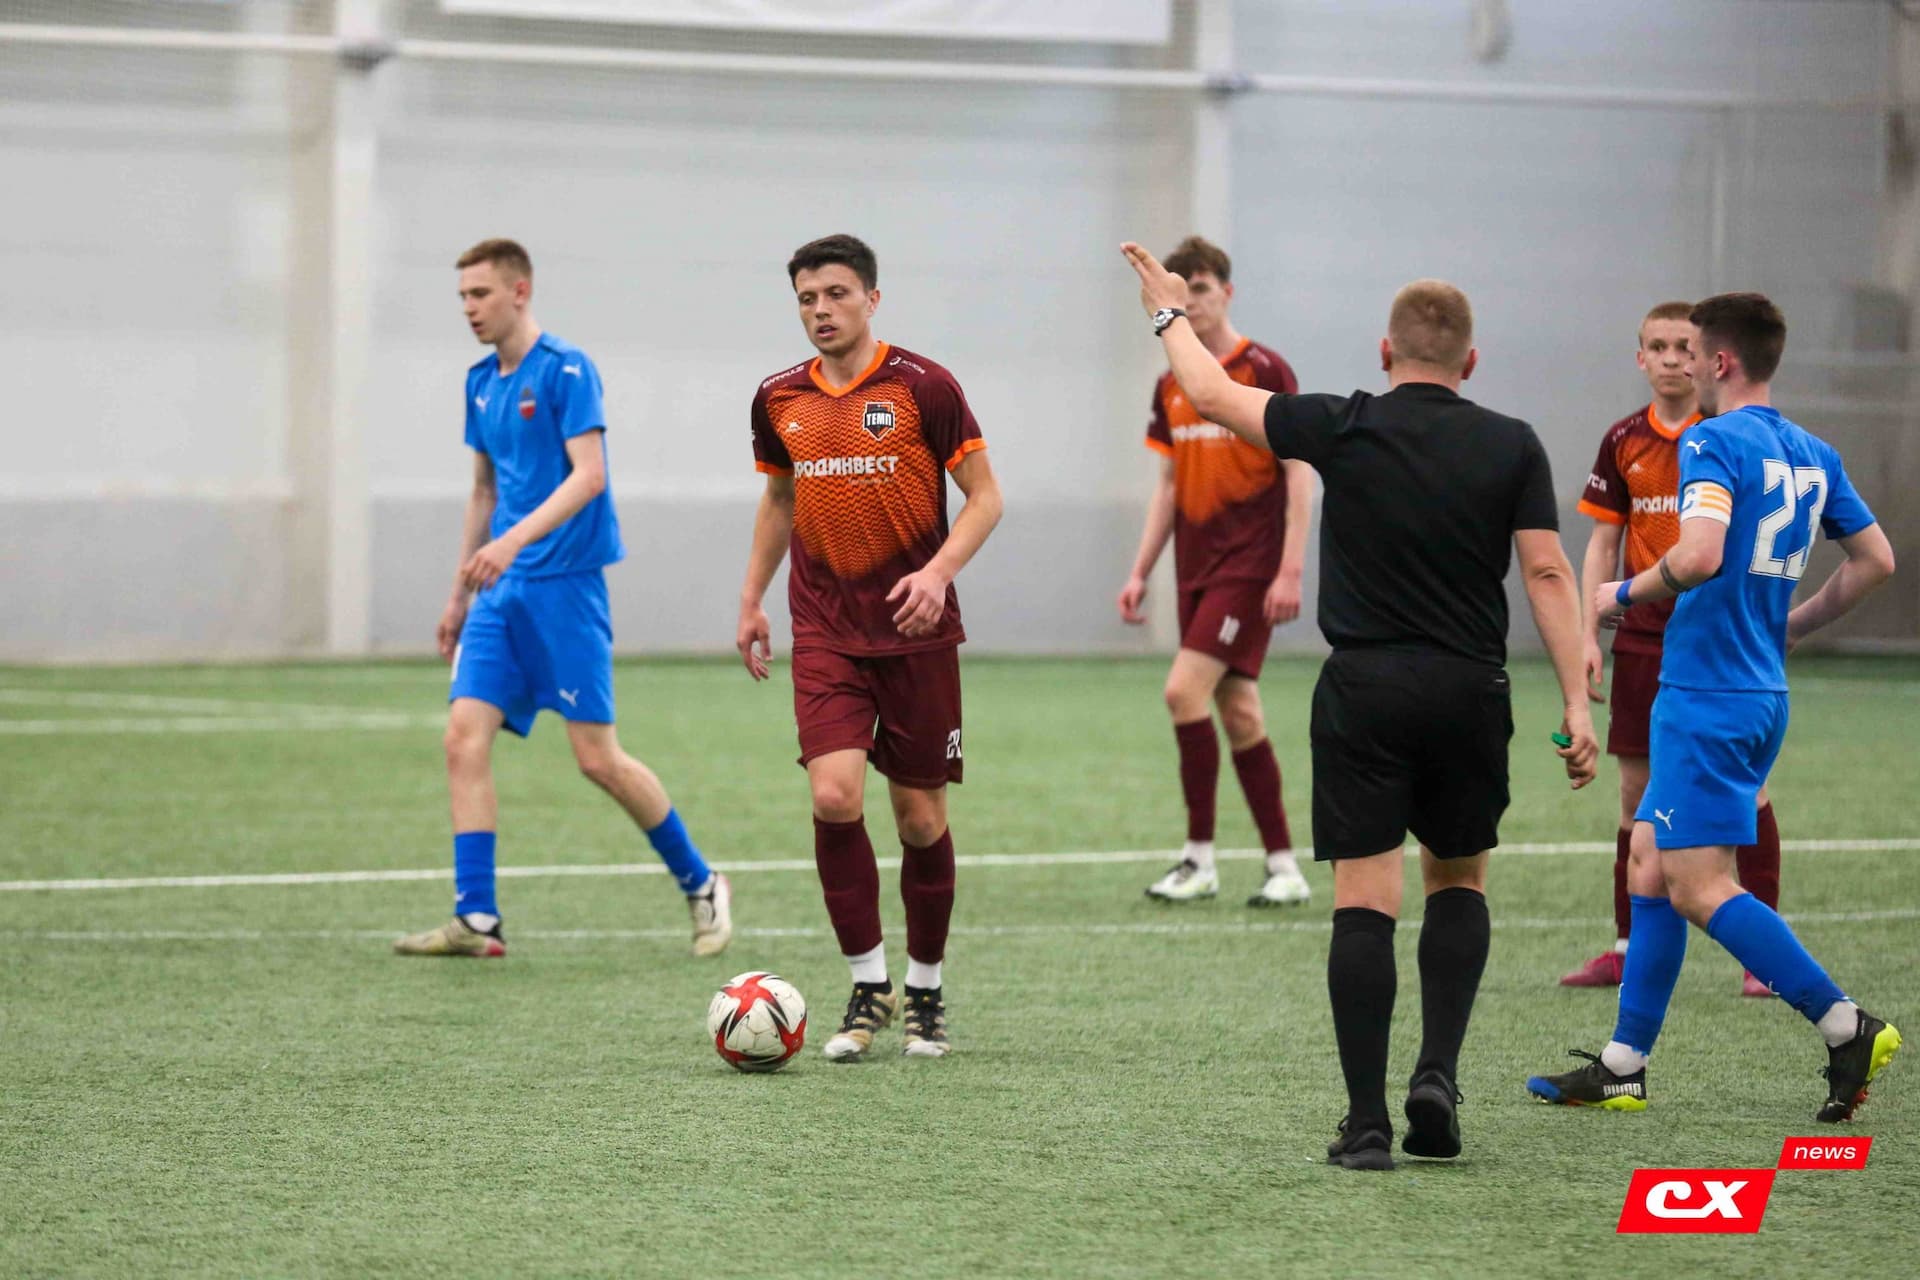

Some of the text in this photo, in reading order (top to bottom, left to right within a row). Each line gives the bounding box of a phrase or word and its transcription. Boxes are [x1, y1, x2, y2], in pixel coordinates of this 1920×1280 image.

[866, 412, 892, 426] ТЕМП
[1748, 458, 1828, 581] 23
[1603, 1083, 1641, 1097] PUMA
